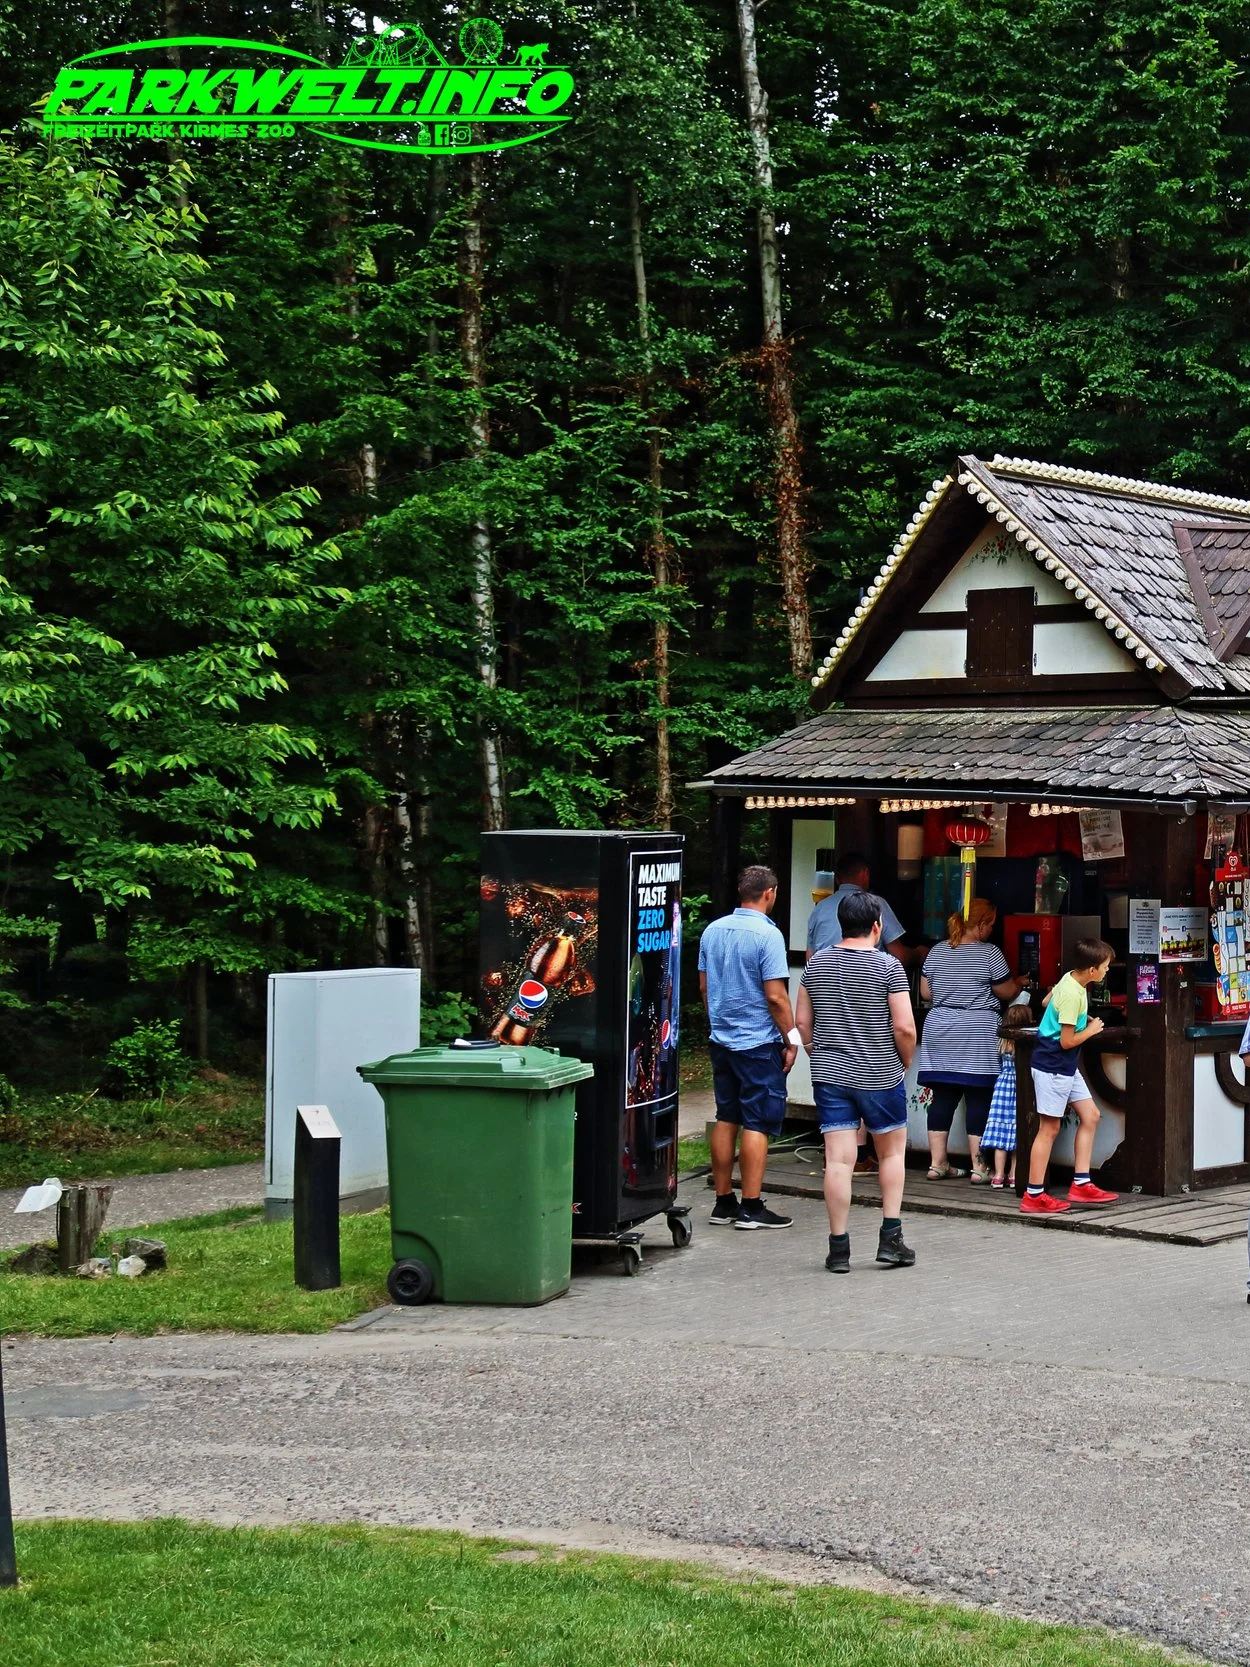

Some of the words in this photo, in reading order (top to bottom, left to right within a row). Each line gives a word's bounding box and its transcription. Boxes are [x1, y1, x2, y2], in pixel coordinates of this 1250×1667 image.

[638, 886, 666, 907] TASTE
[637, 908, 665, 930] ZERO
[637, 930, 670, 953] SUGAR
